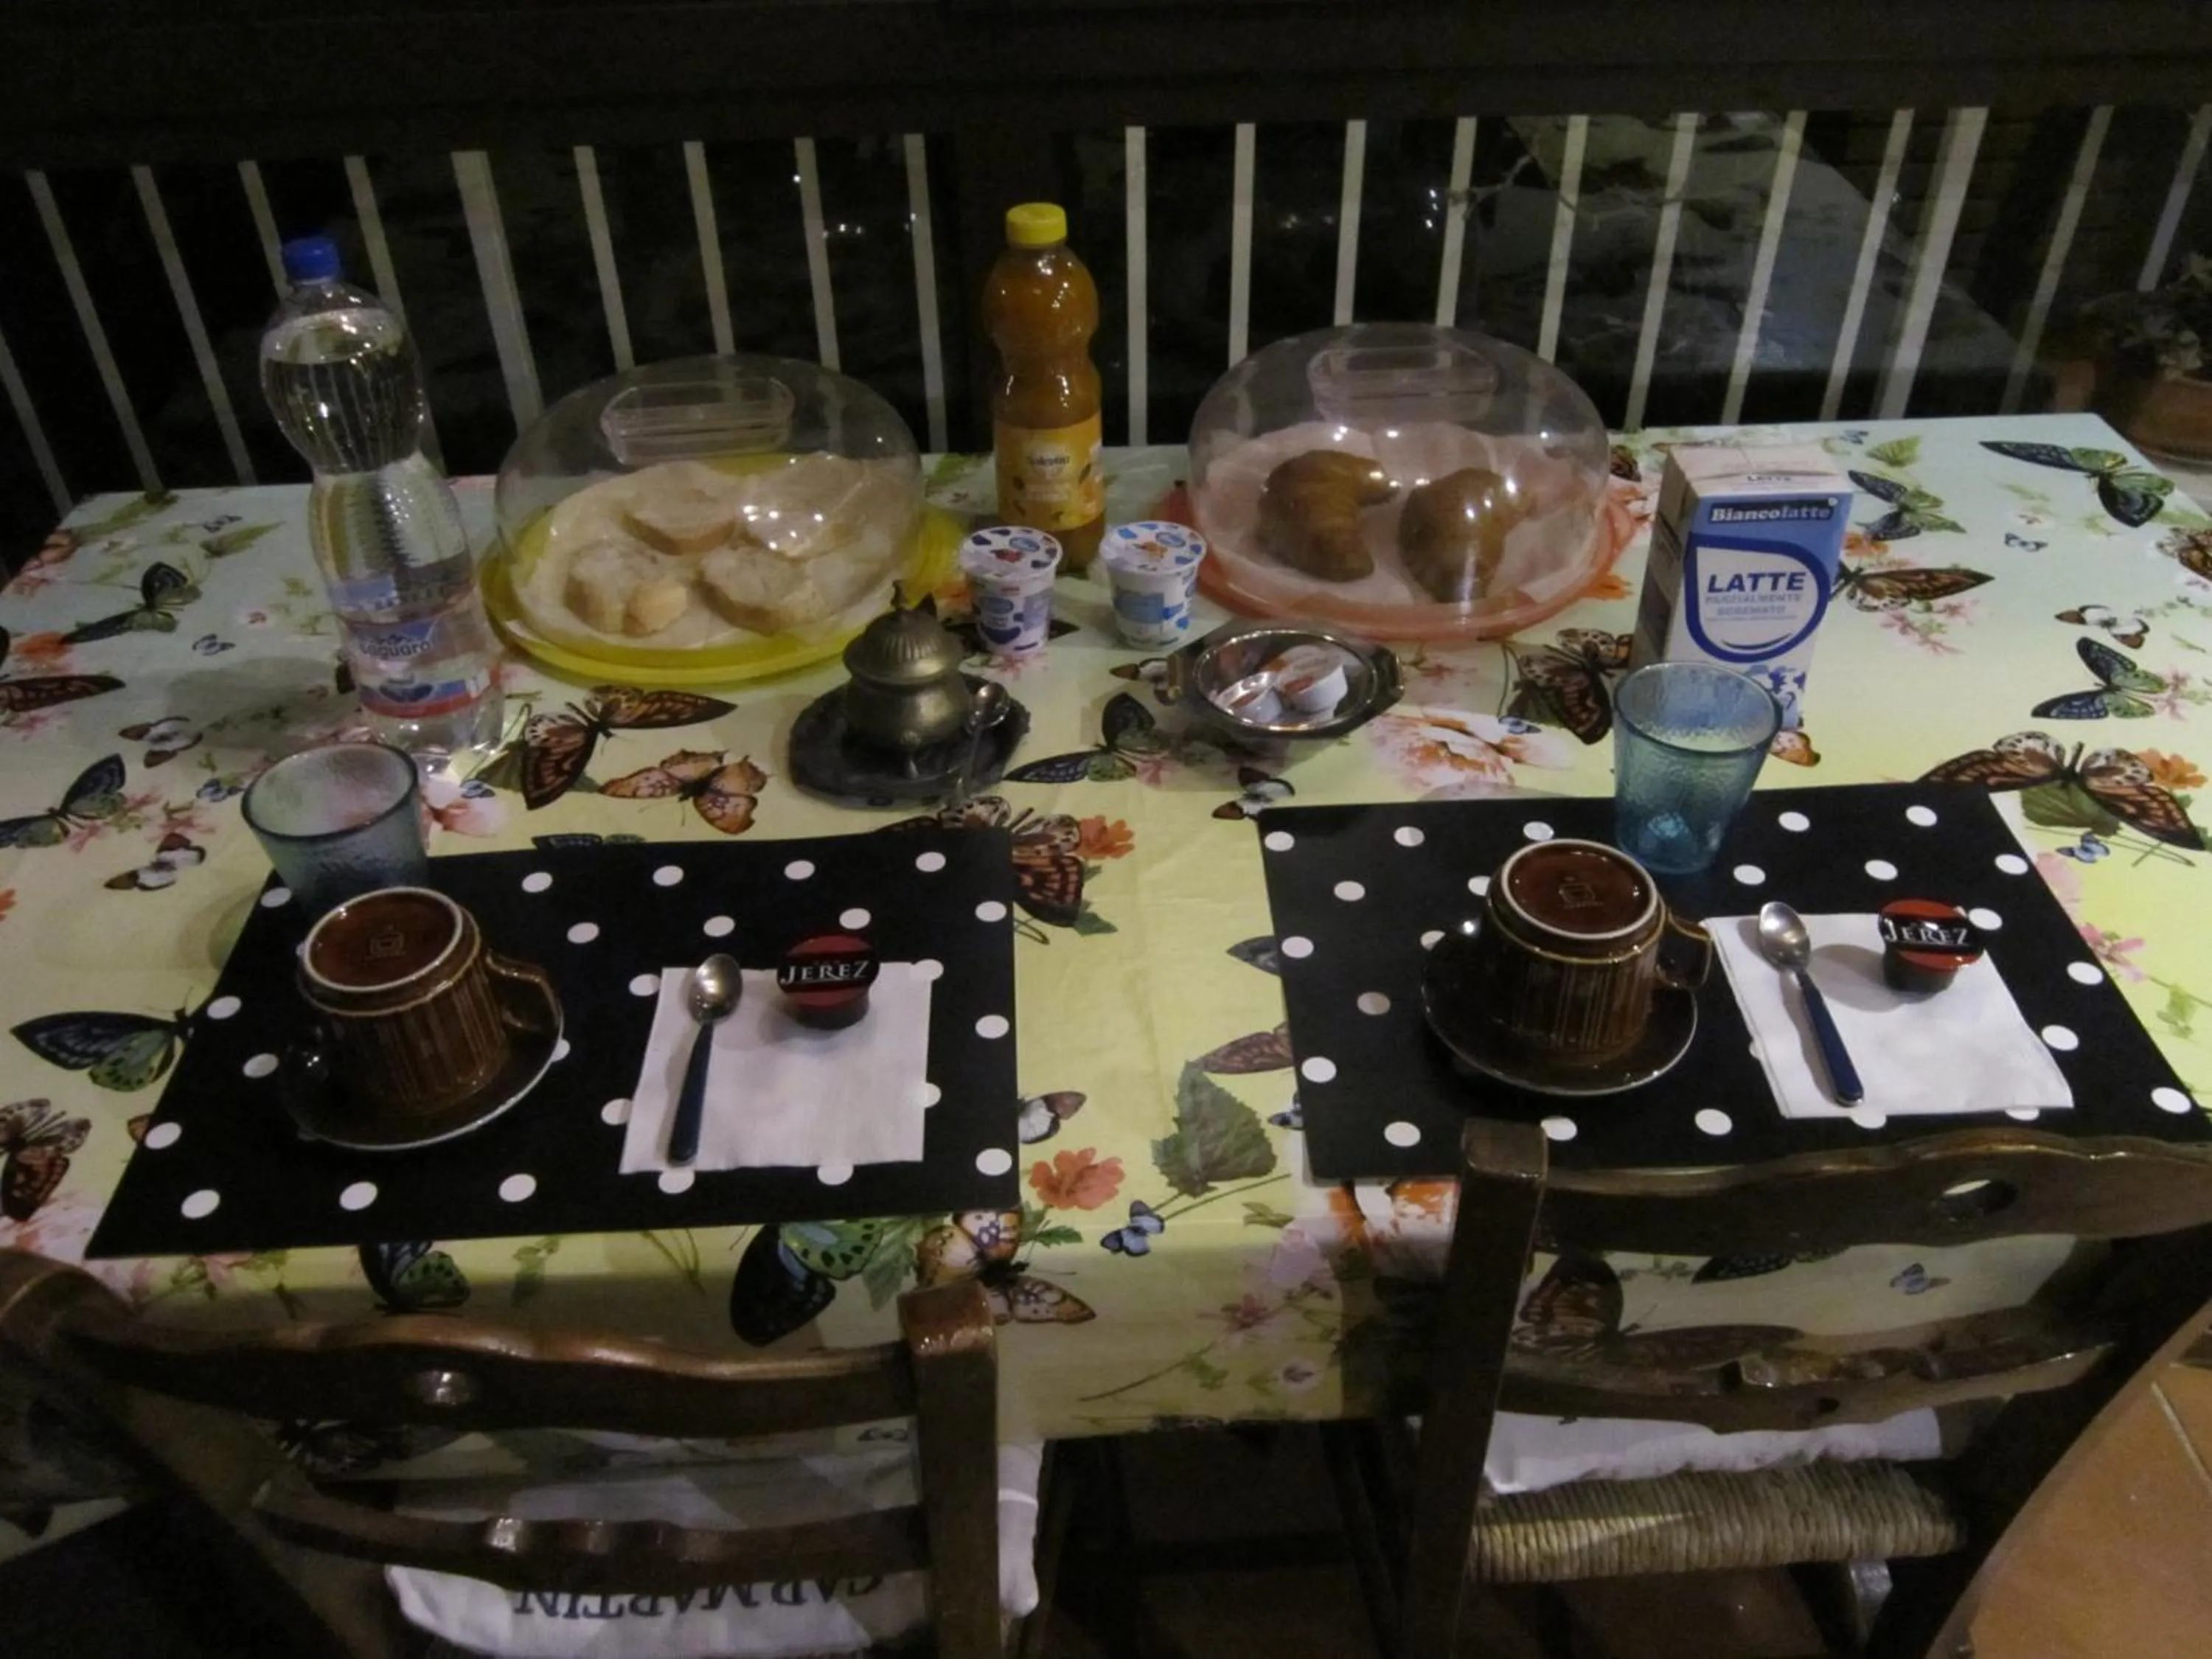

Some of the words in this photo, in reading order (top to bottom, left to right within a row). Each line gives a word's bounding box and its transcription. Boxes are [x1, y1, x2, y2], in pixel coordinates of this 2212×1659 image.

[1710, 504, 1832, 522] Biancolatte
[1707, 571, 1806, 593] LATTE
[1884, 918, 1970, 945] JEREZ
[779, 960, 869, 985] JEREZ
